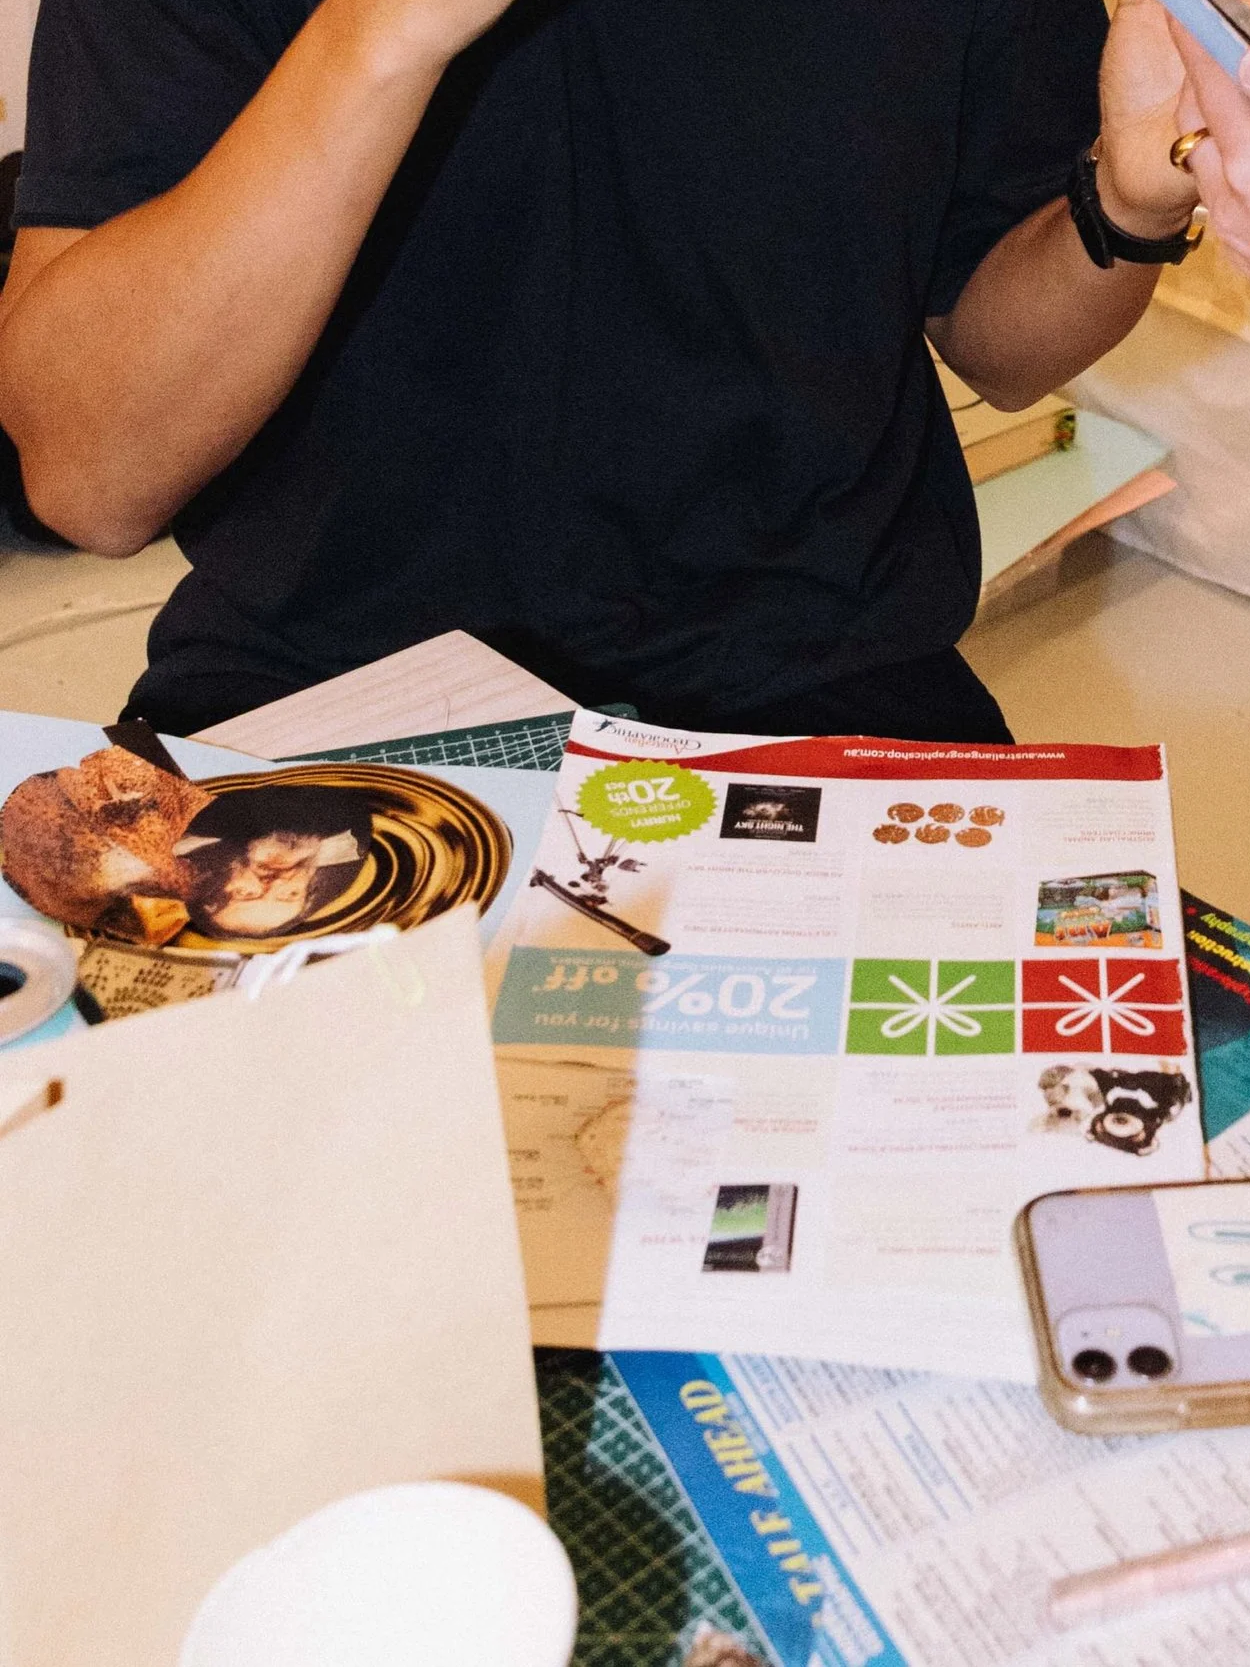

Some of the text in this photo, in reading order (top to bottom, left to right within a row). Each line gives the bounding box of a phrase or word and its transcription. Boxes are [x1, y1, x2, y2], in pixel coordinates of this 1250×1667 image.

[635, 970, 818, 1019] 20%
[534, 1012, 810, 1039] Unique savings for you
[679, 1379, 781, 1498] AHEAD
